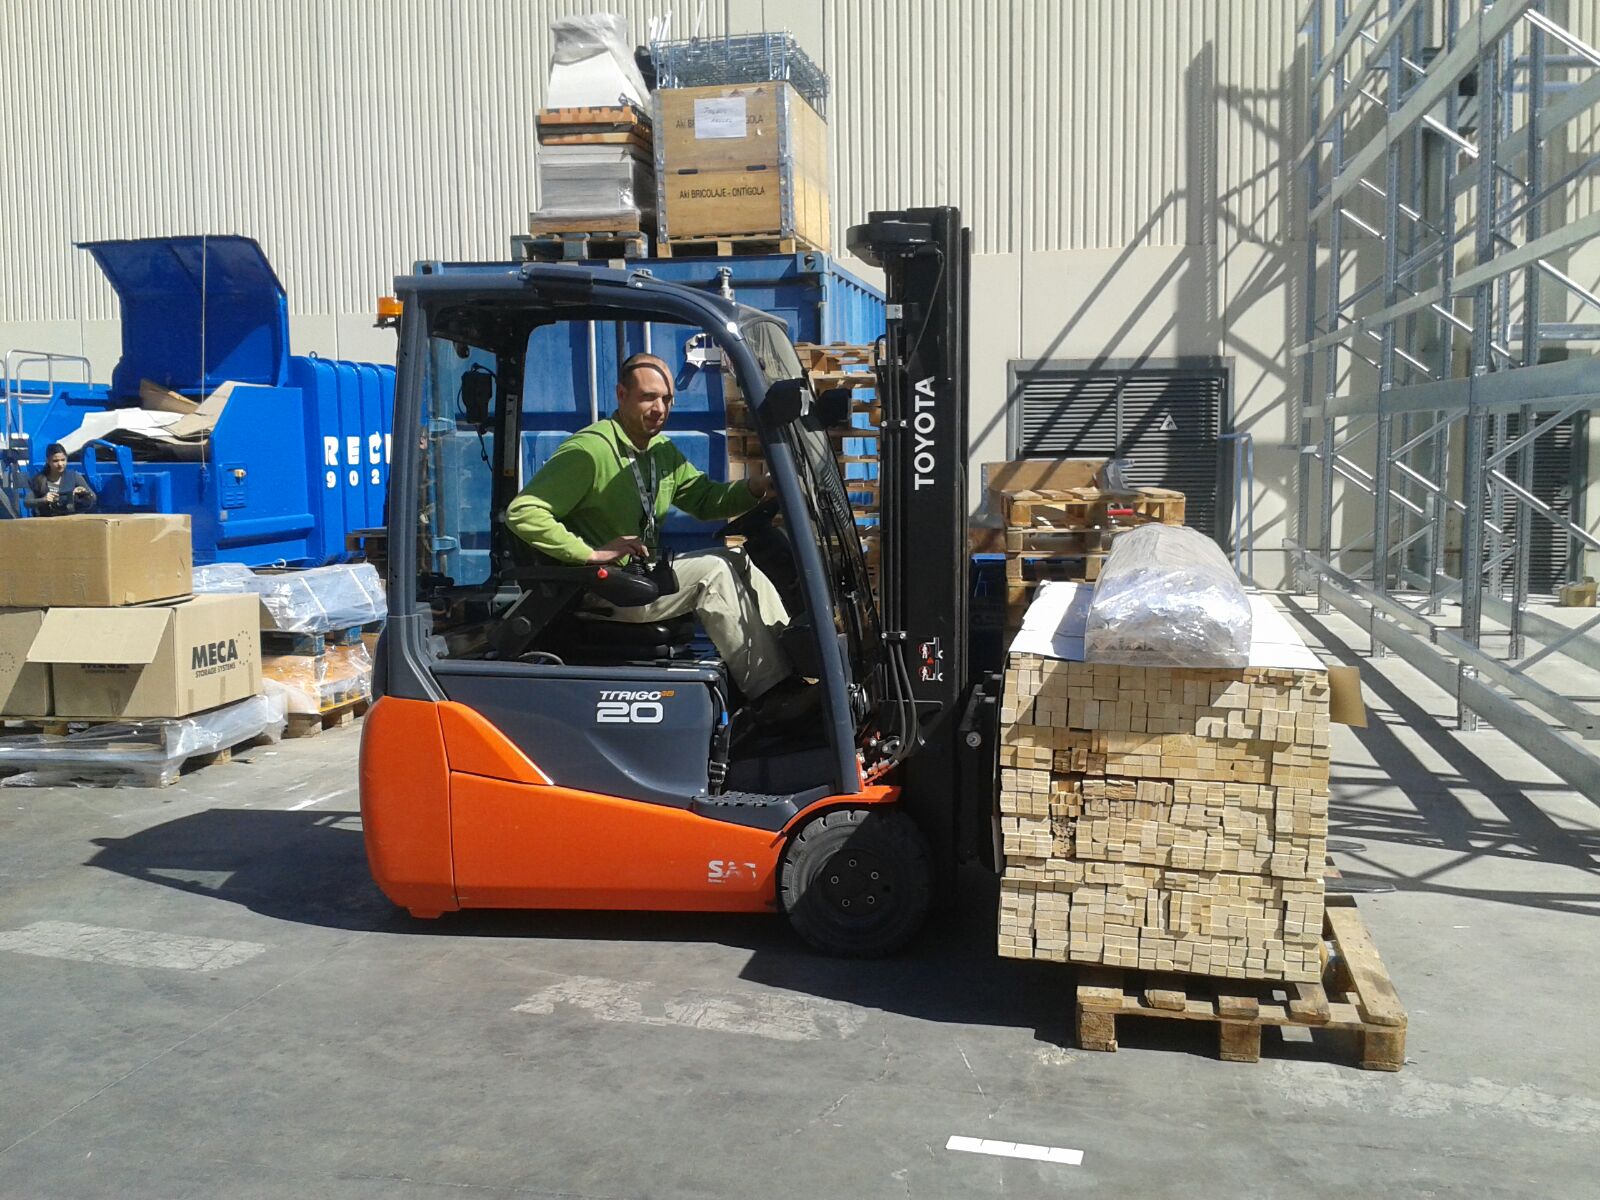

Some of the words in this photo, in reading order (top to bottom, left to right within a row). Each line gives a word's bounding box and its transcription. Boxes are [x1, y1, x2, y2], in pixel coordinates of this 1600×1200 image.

[691, 187, 727, 199] BRICOLAJE
[914, 376, 935, 490] TOYOTA
[191, 638, 238, 670] MECA
[195, 667, 217, 679] STORAGE
[217, 663, 236, 673] SYSTEMS
[596, 701, 664, 723] 20
